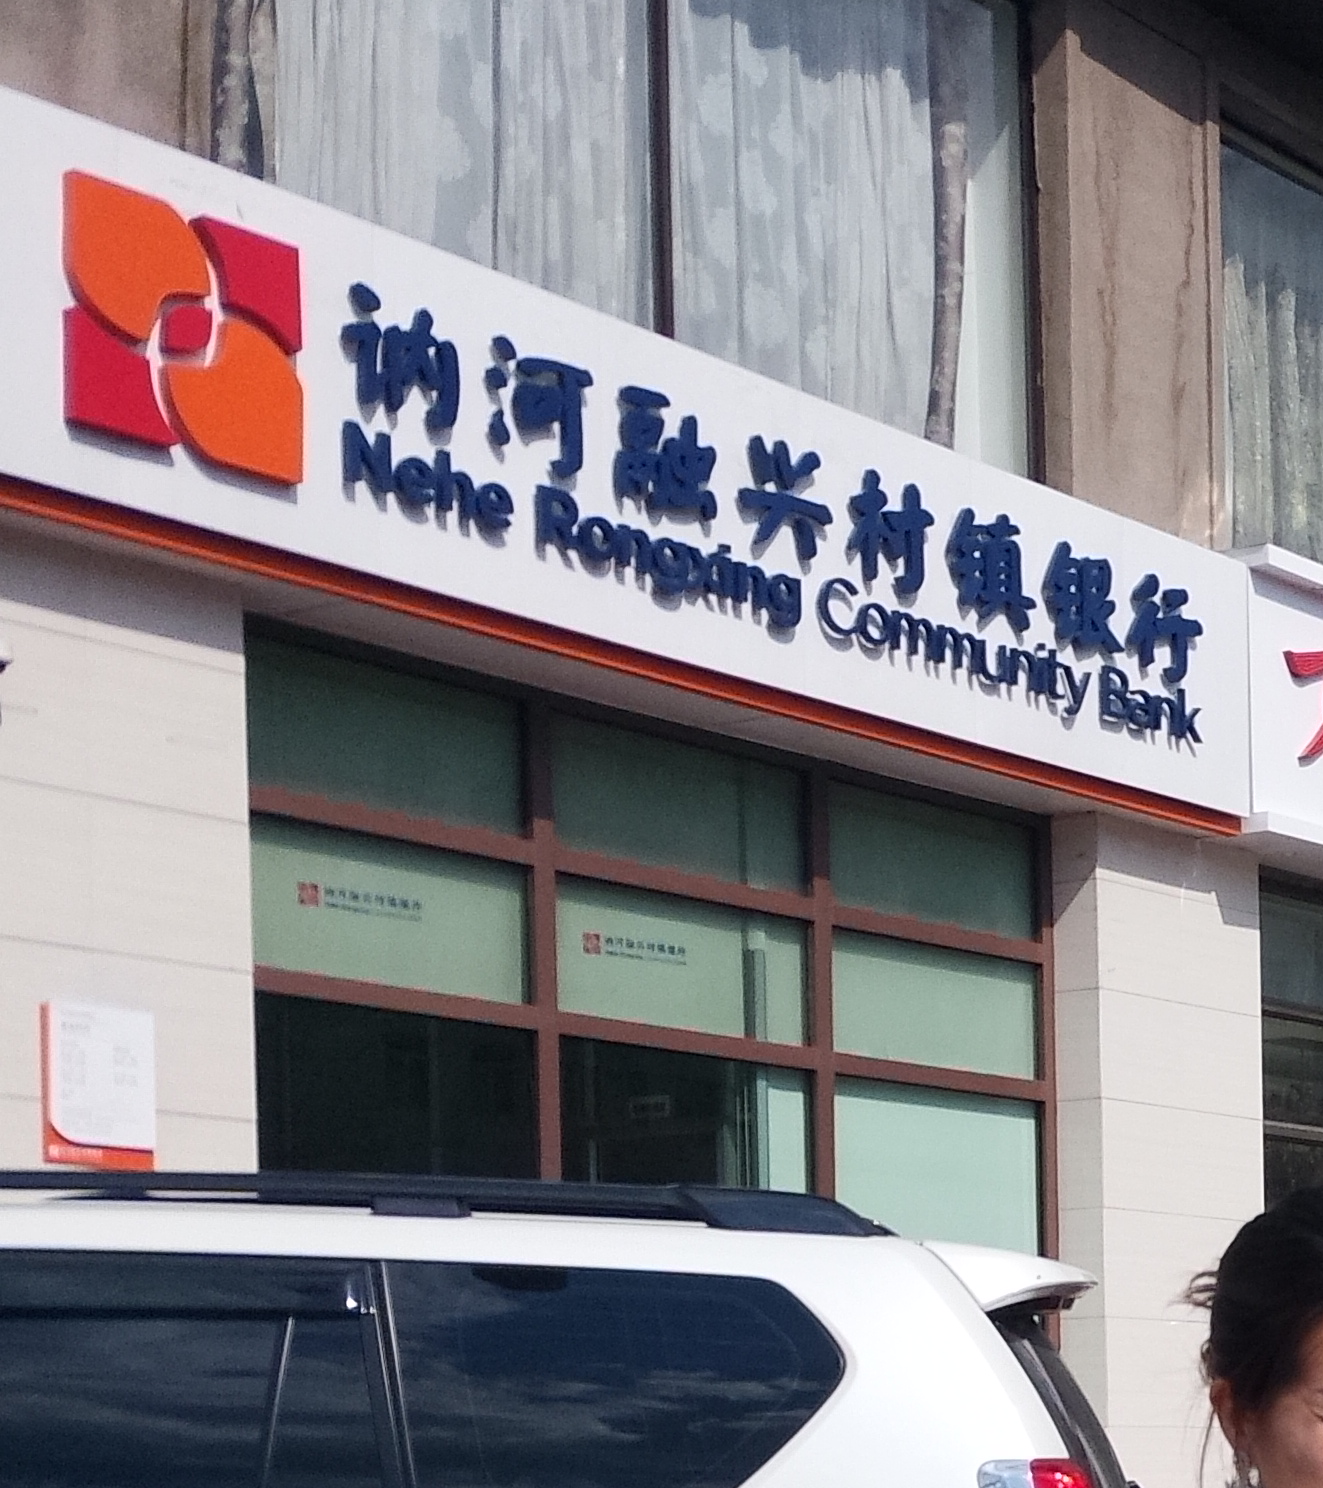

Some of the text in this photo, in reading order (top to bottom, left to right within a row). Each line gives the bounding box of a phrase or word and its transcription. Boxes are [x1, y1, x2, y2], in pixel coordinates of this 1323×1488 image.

[340, 282, 1204, 686] 讷河融兴村镇银行
[341, 419, 1203, 745] Nehe Rongxing Community Bank
